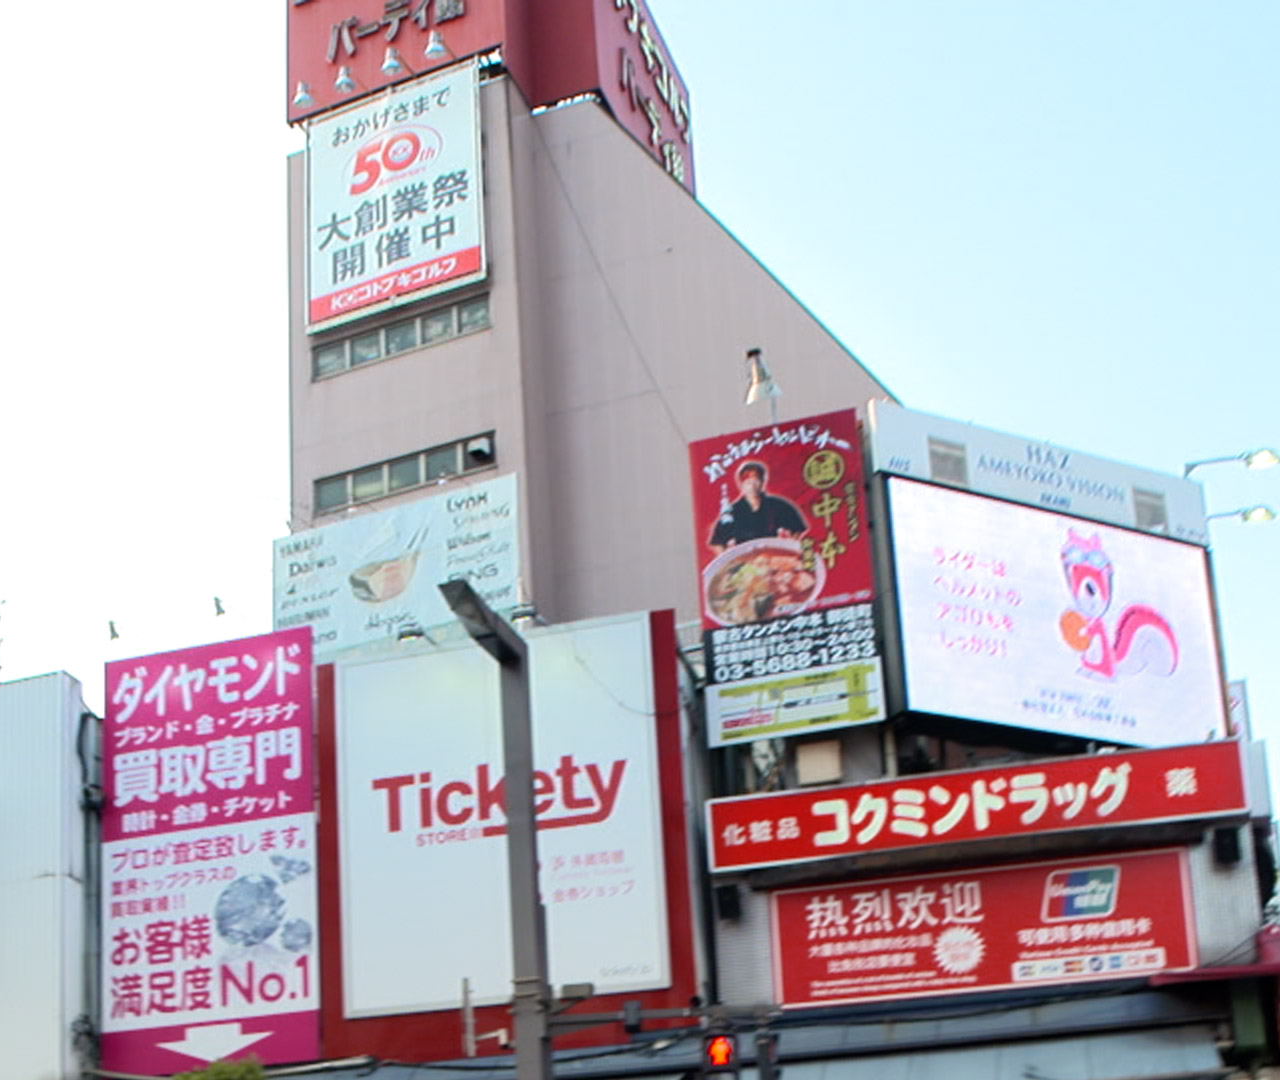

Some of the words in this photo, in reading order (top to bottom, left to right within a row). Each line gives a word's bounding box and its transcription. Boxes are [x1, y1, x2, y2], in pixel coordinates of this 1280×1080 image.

[332, 86, 451, 148] おかげさまで
[317, 168, 469, 251] 大創業祭
[332, 214, 456, 285] 開催中
[112, 642, 302, 724] ダイヤモンド
[714, 640, 877, 683] 03-5688-1233
[114, 702, 299, 748] ブランド・金・プラチナ
[113, 726, 303, 807] 買取専門
[372, 754, 628, 833] Tickety
[721, 816, 801, 847] 化粧品
[811, 761, 1133, 848] コクミンドラッグ
[1164, 766, 1198, 798] 薬
[111, 913, 213, 967] お客様
[805, 880, 986, 940] 热烈欢迎
